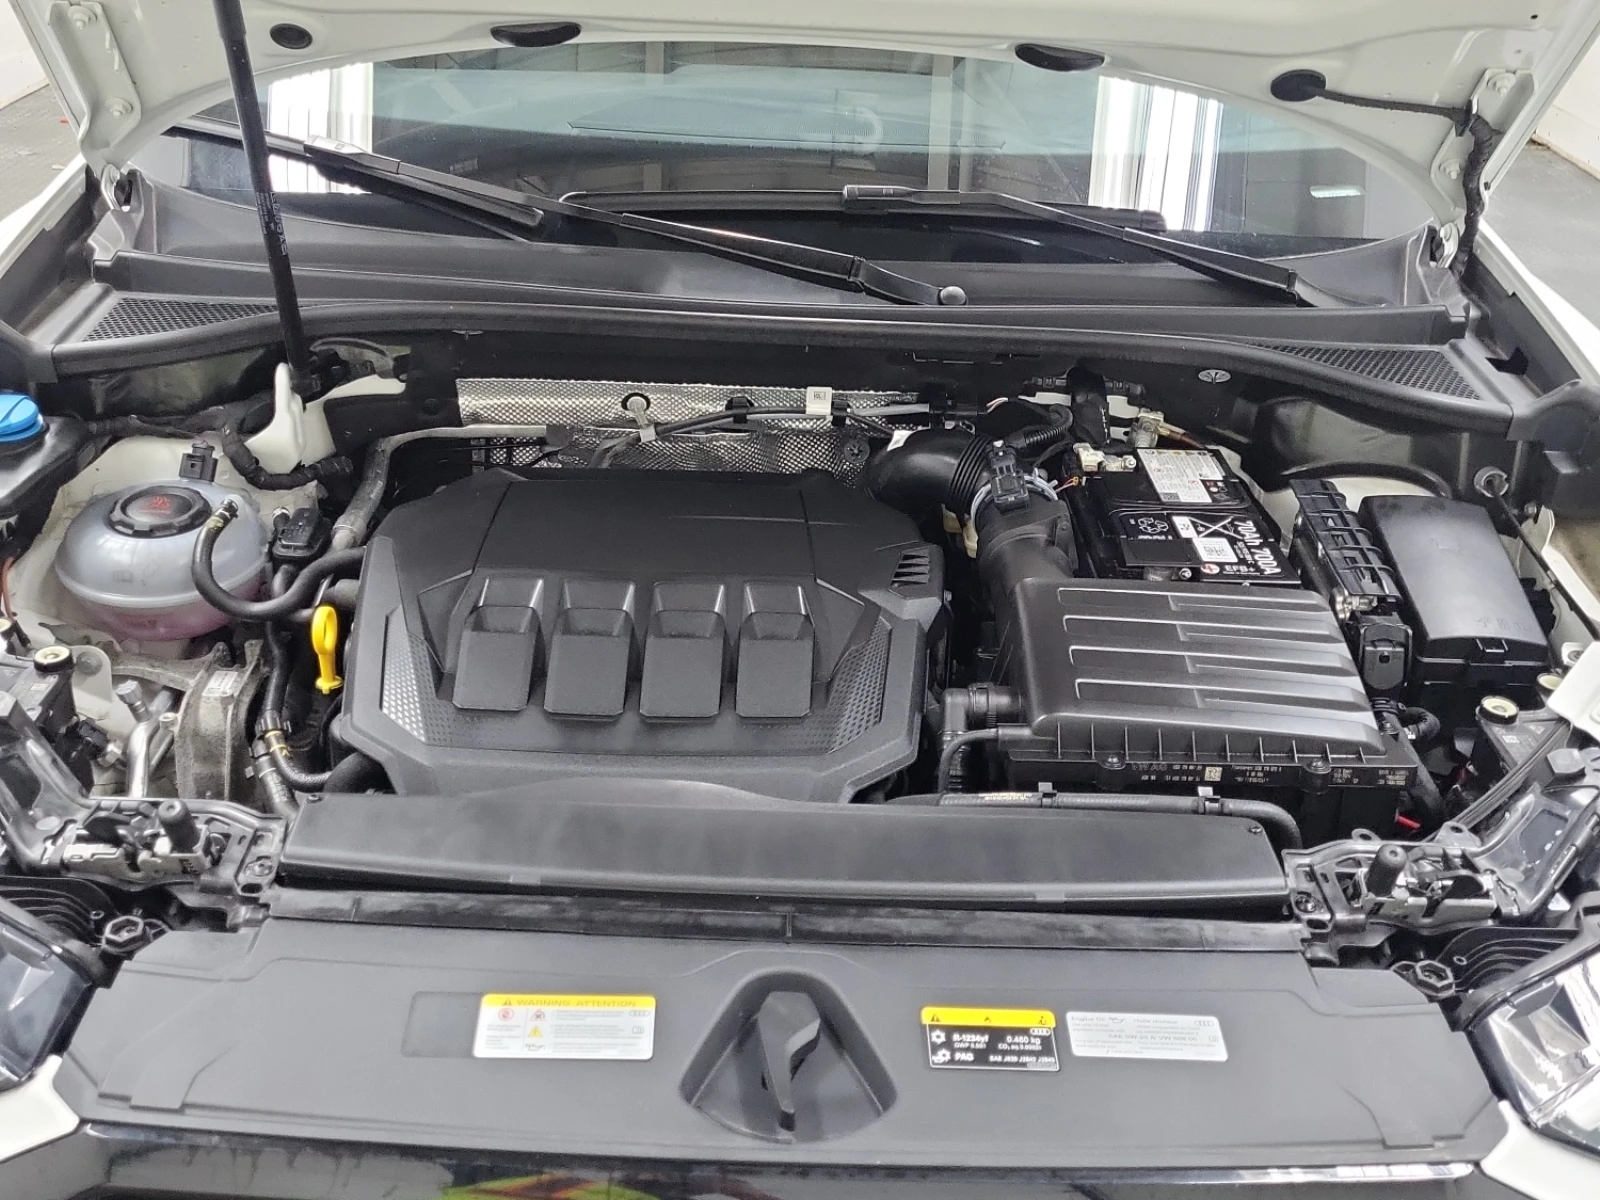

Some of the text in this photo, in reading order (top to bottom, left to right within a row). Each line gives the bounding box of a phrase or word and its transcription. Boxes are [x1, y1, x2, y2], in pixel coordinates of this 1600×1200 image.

[1233, 520, 1264, 546] 70Ah
[1250, 547, 1282, 575] 700A
[517, 999, 637, 1008] WARNING ATTENTION
[954, 1052, 974, 1061] PAG
